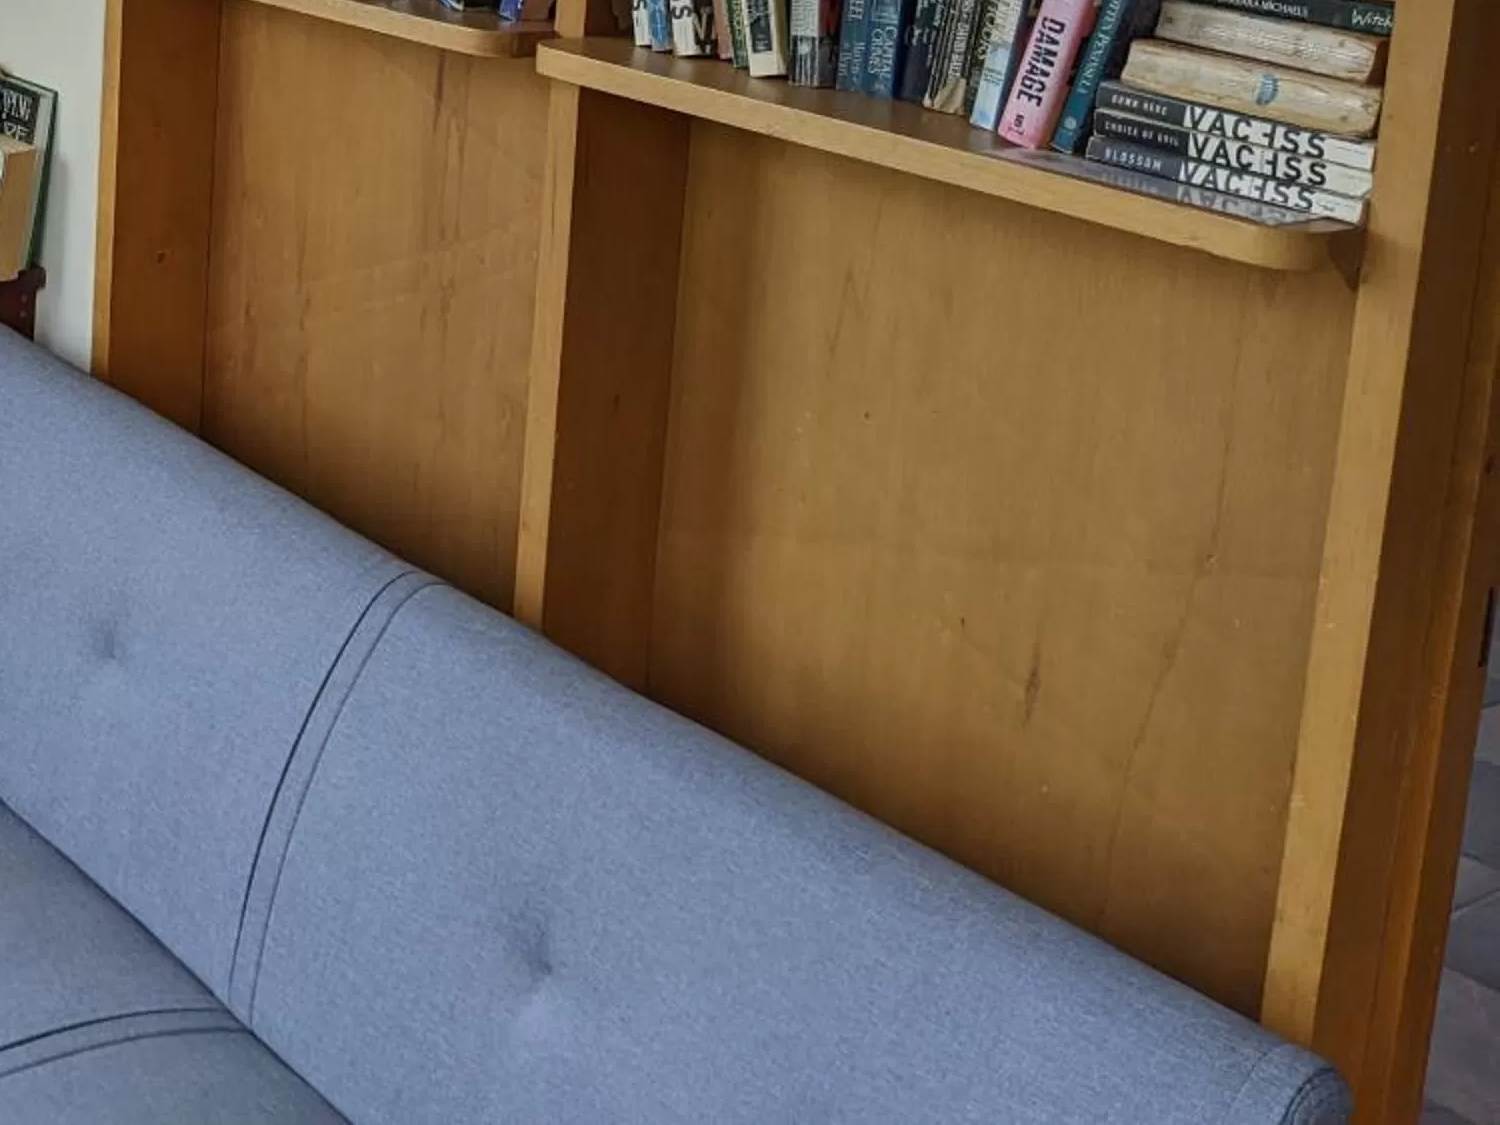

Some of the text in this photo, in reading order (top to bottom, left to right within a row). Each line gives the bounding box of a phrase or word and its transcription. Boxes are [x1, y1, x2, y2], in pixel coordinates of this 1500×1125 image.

[878, 26, 897, 82] CAPITAL
[1016, 16, 1066, 108] DAMAGE
[1077, 36, 1110, 95] PENINSULA
[1185, 106, 1325, 158] VACHSS
[1189, 133, 1328, 185] VACHSS
[1104, 149, 1314, 213] BLOSSOM VACHSS
